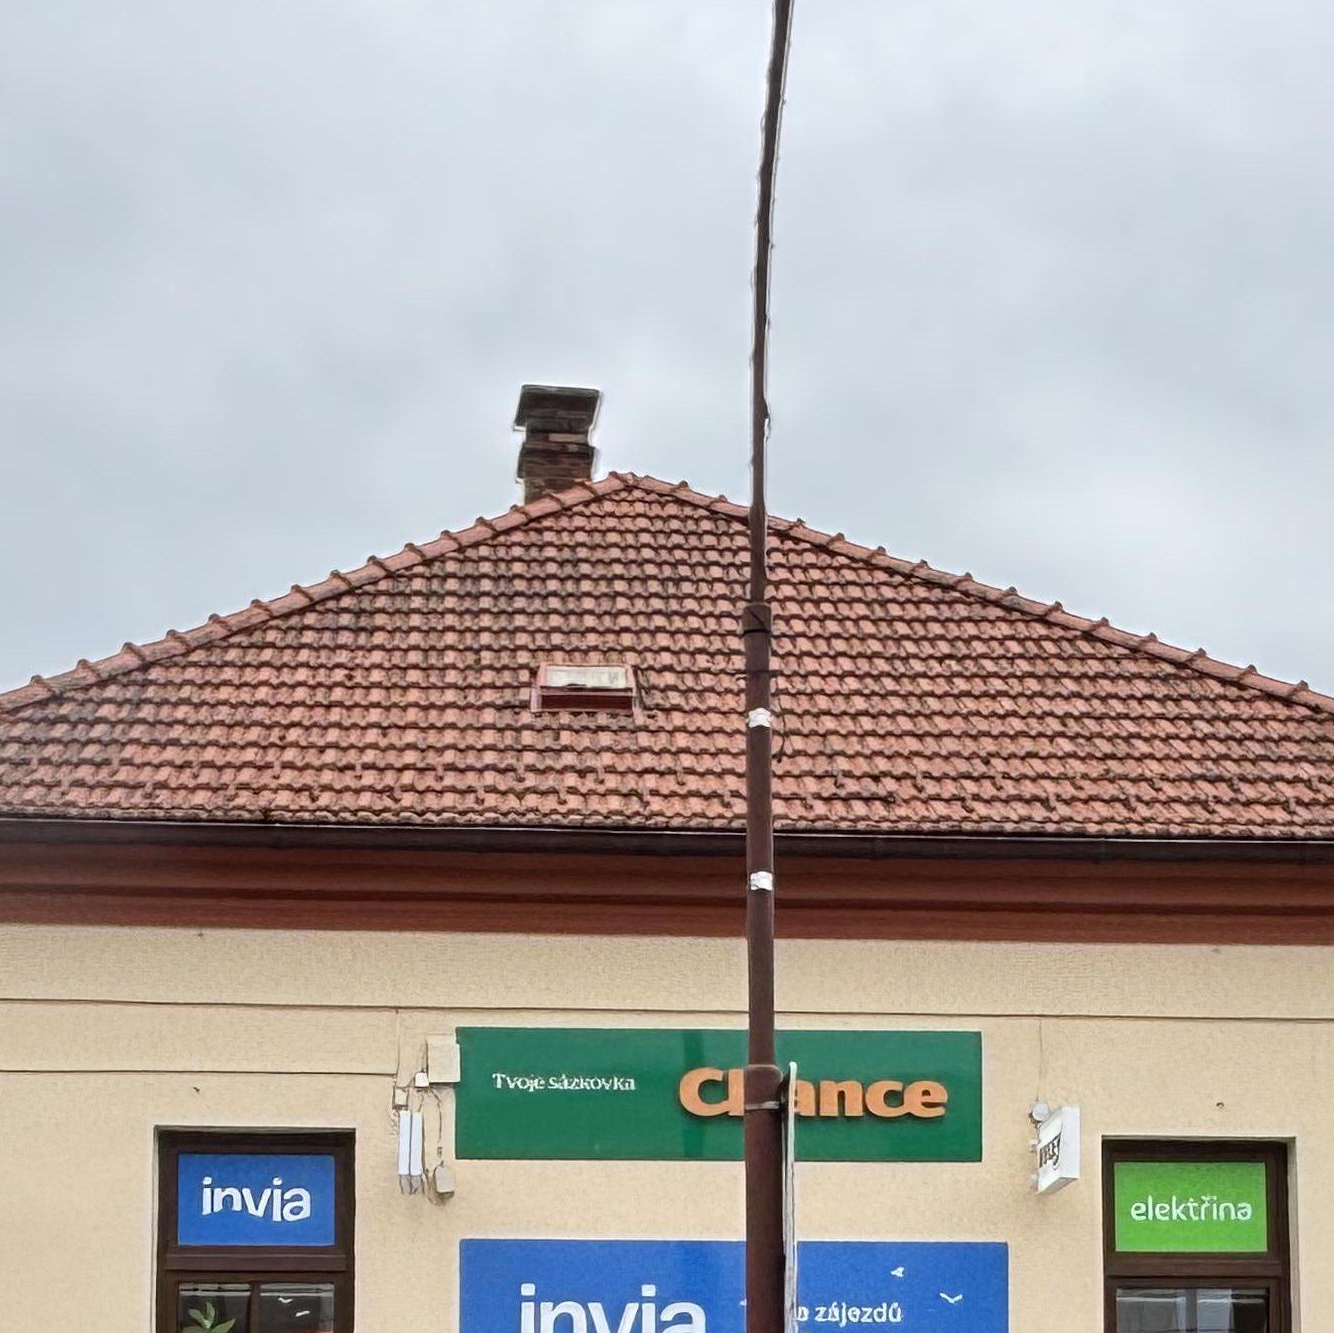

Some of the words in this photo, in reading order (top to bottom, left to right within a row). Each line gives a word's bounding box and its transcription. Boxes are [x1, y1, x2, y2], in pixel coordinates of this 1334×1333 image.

[492, 1073, 544, 1092] Tvoje
[202, 1176, 311, 1222] invia
[1130, 1194, 1253, 1221] elektřina
[815, 1301, 903, 1327] zájezdů
